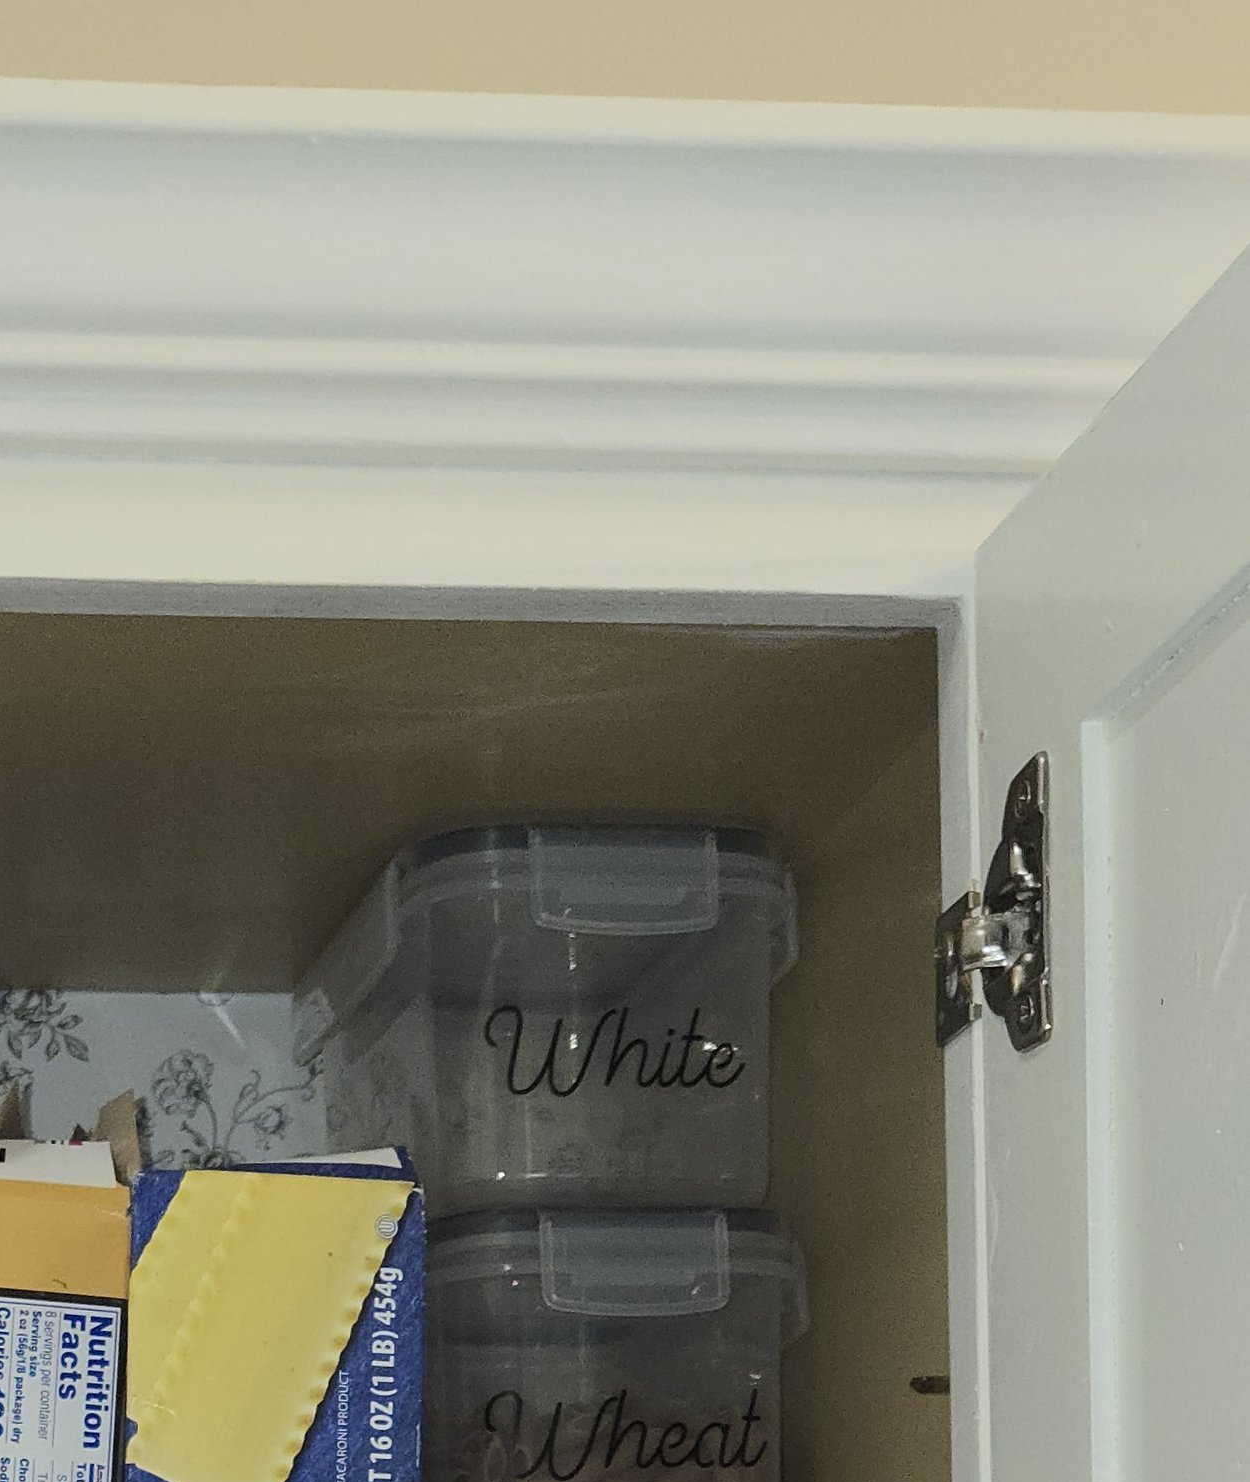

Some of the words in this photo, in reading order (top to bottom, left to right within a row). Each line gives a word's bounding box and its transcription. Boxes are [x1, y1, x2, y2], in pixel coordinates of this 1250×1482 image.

[485, 1005, 746, 1097] White
[374, 1267, 403, 1326] 454g
[59, 1313, 86, 1400] Facts
[372, 1331, 399, 1368] LB)
[83, 1316, 113, 1449] Nutrition
[338, 1370, 351, 1426] PRODUCT
[370, 1374, 397, 1397] (1
[370, 1401, 393, 1431] OZ
[485, 1388, 768, 1482] Wheat
[371, 1435, 393, 1463] 16
